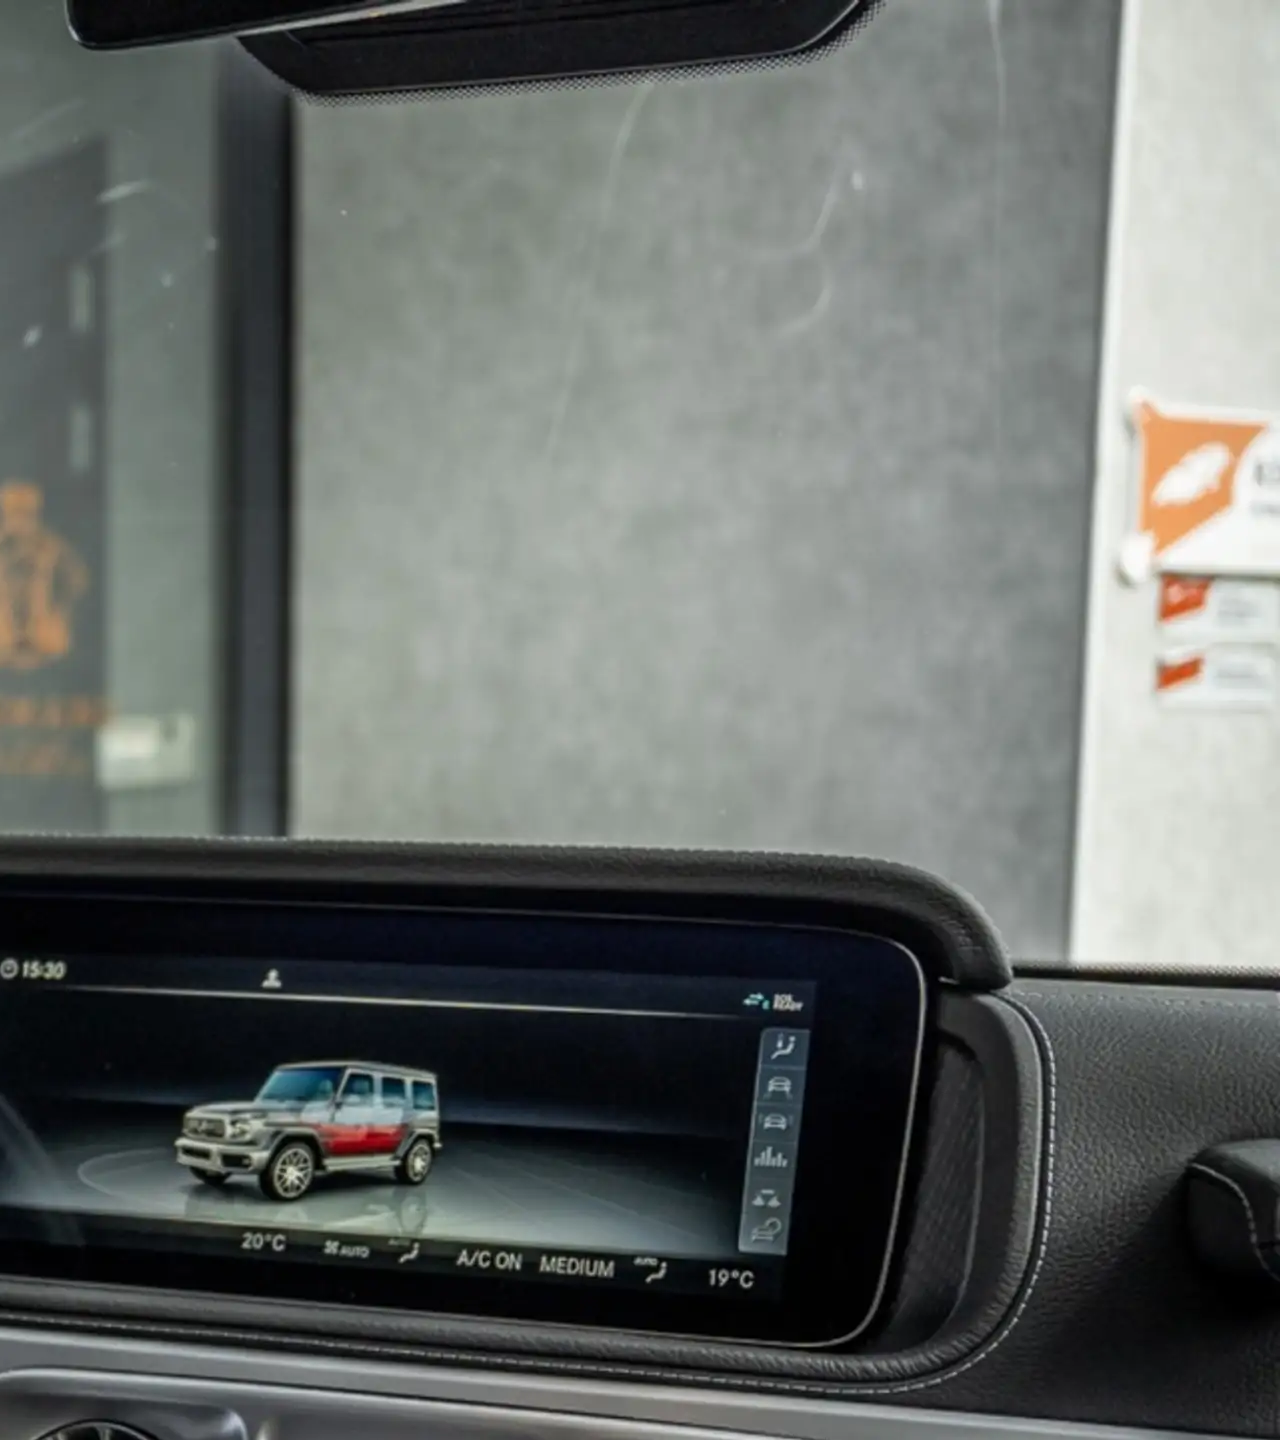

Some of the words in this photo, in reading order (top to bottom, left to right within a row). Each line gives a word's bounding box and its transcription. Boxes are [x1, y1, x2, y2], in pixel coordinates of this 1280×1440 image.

[241, 1231, 287, 1252] 20°C
[455, 1248, 490, 1269] A/C
[495, 1251, 523, 1271] ON
[539, 1254, 616, 1279] MEDIUM
[708, 1268, 755, 1289] 19°C
